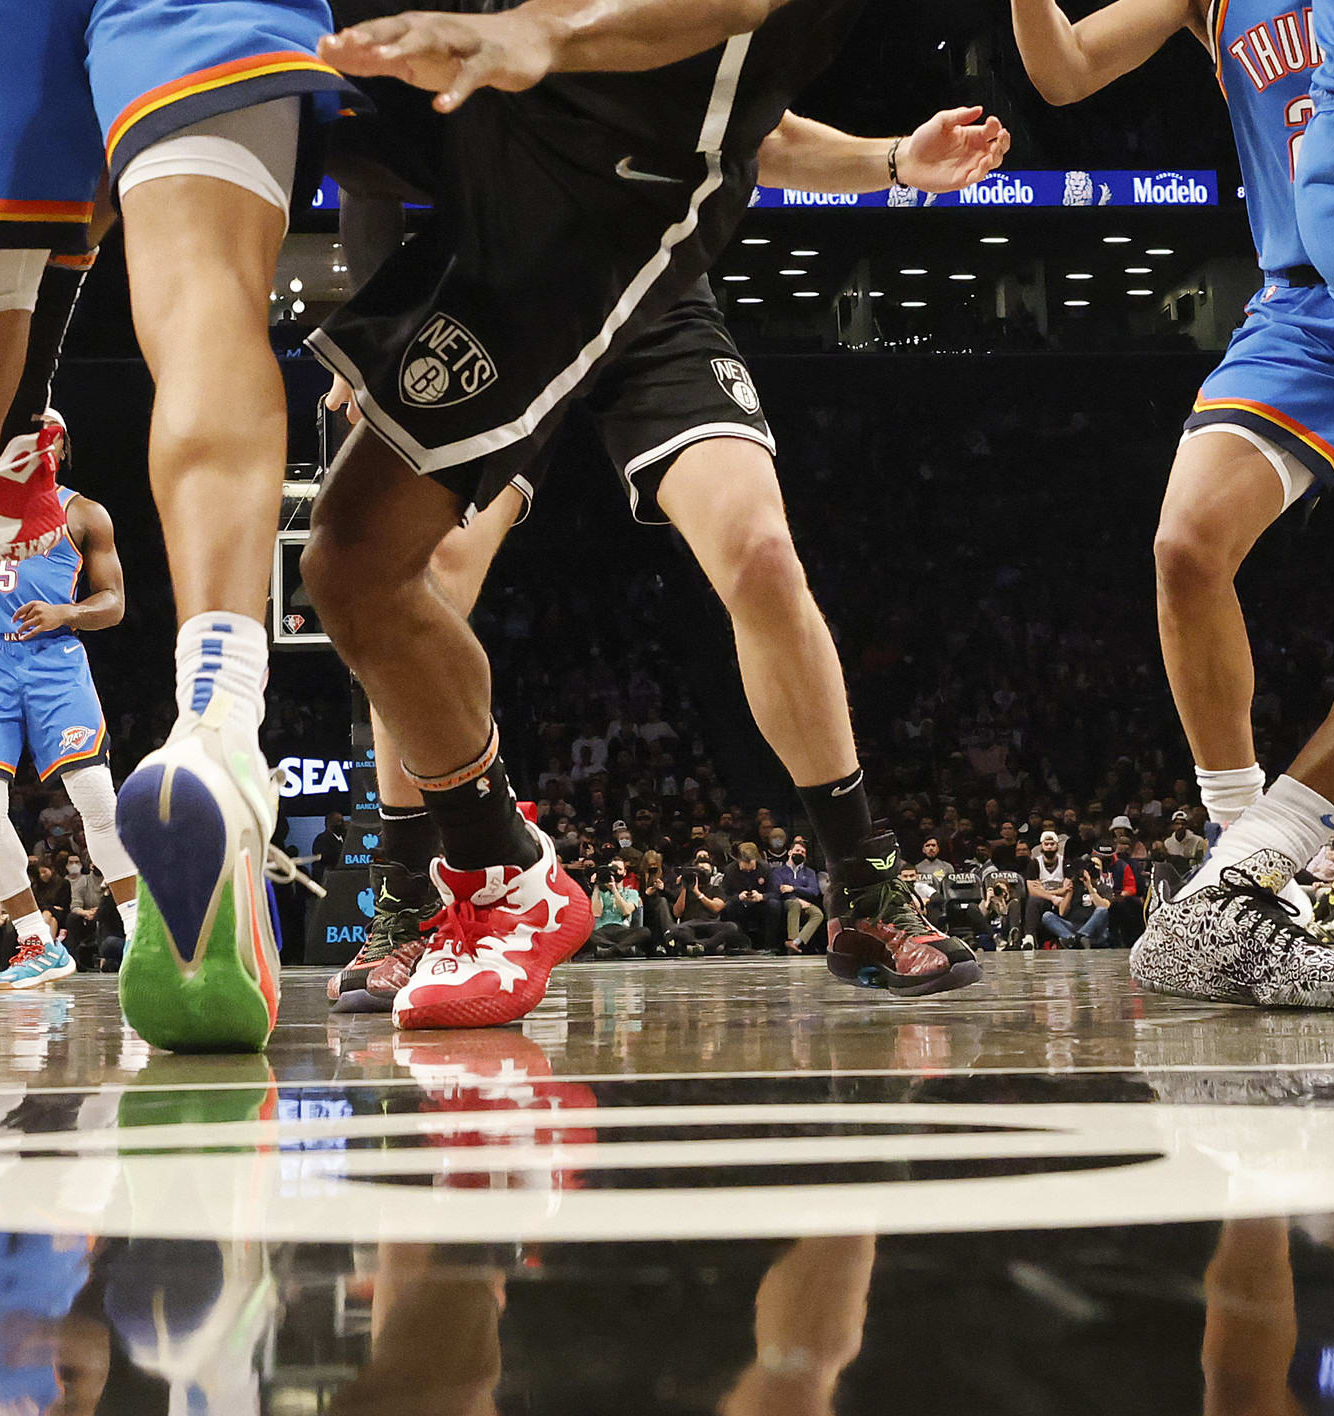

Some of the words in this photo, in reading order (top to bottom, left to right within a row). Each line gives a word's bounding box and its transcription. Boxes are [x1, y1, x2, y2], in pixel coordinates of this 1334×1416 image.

[959, 179, 1034, 204] Modelo
[1133, 177, 1208, 204] Modelo
[1237, 186, 1246, 199] 8
[417, 316, 492, 393] NETS
